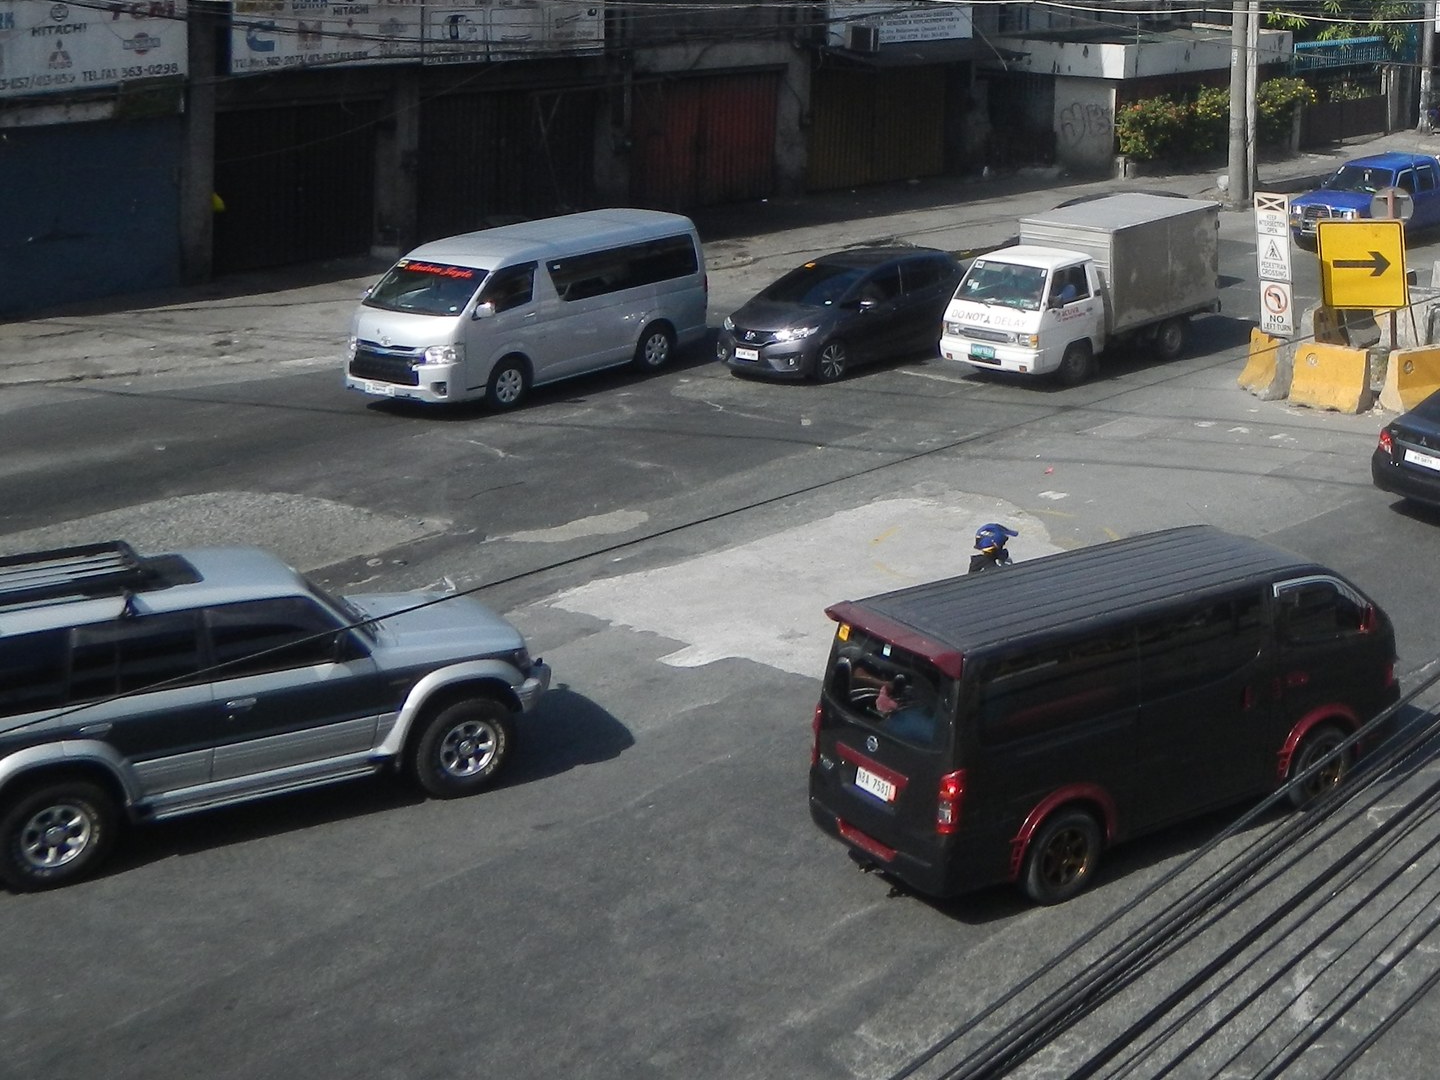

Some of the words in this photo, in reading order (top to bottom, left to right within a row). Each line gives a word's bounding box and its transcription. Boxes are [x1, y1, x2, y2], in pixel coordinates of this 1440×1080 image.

[332, 5, 369, 16] HITACHI
[31, 23, 87, 37] HITACHI
[122, 63, 179, 78] 363-0298
[952, 309, 965, 318] DO
[965, 312, 985, 321] NOT
[994, 317, 1027, 327] DELAY
[1269, 315, 1284, 323] NO
